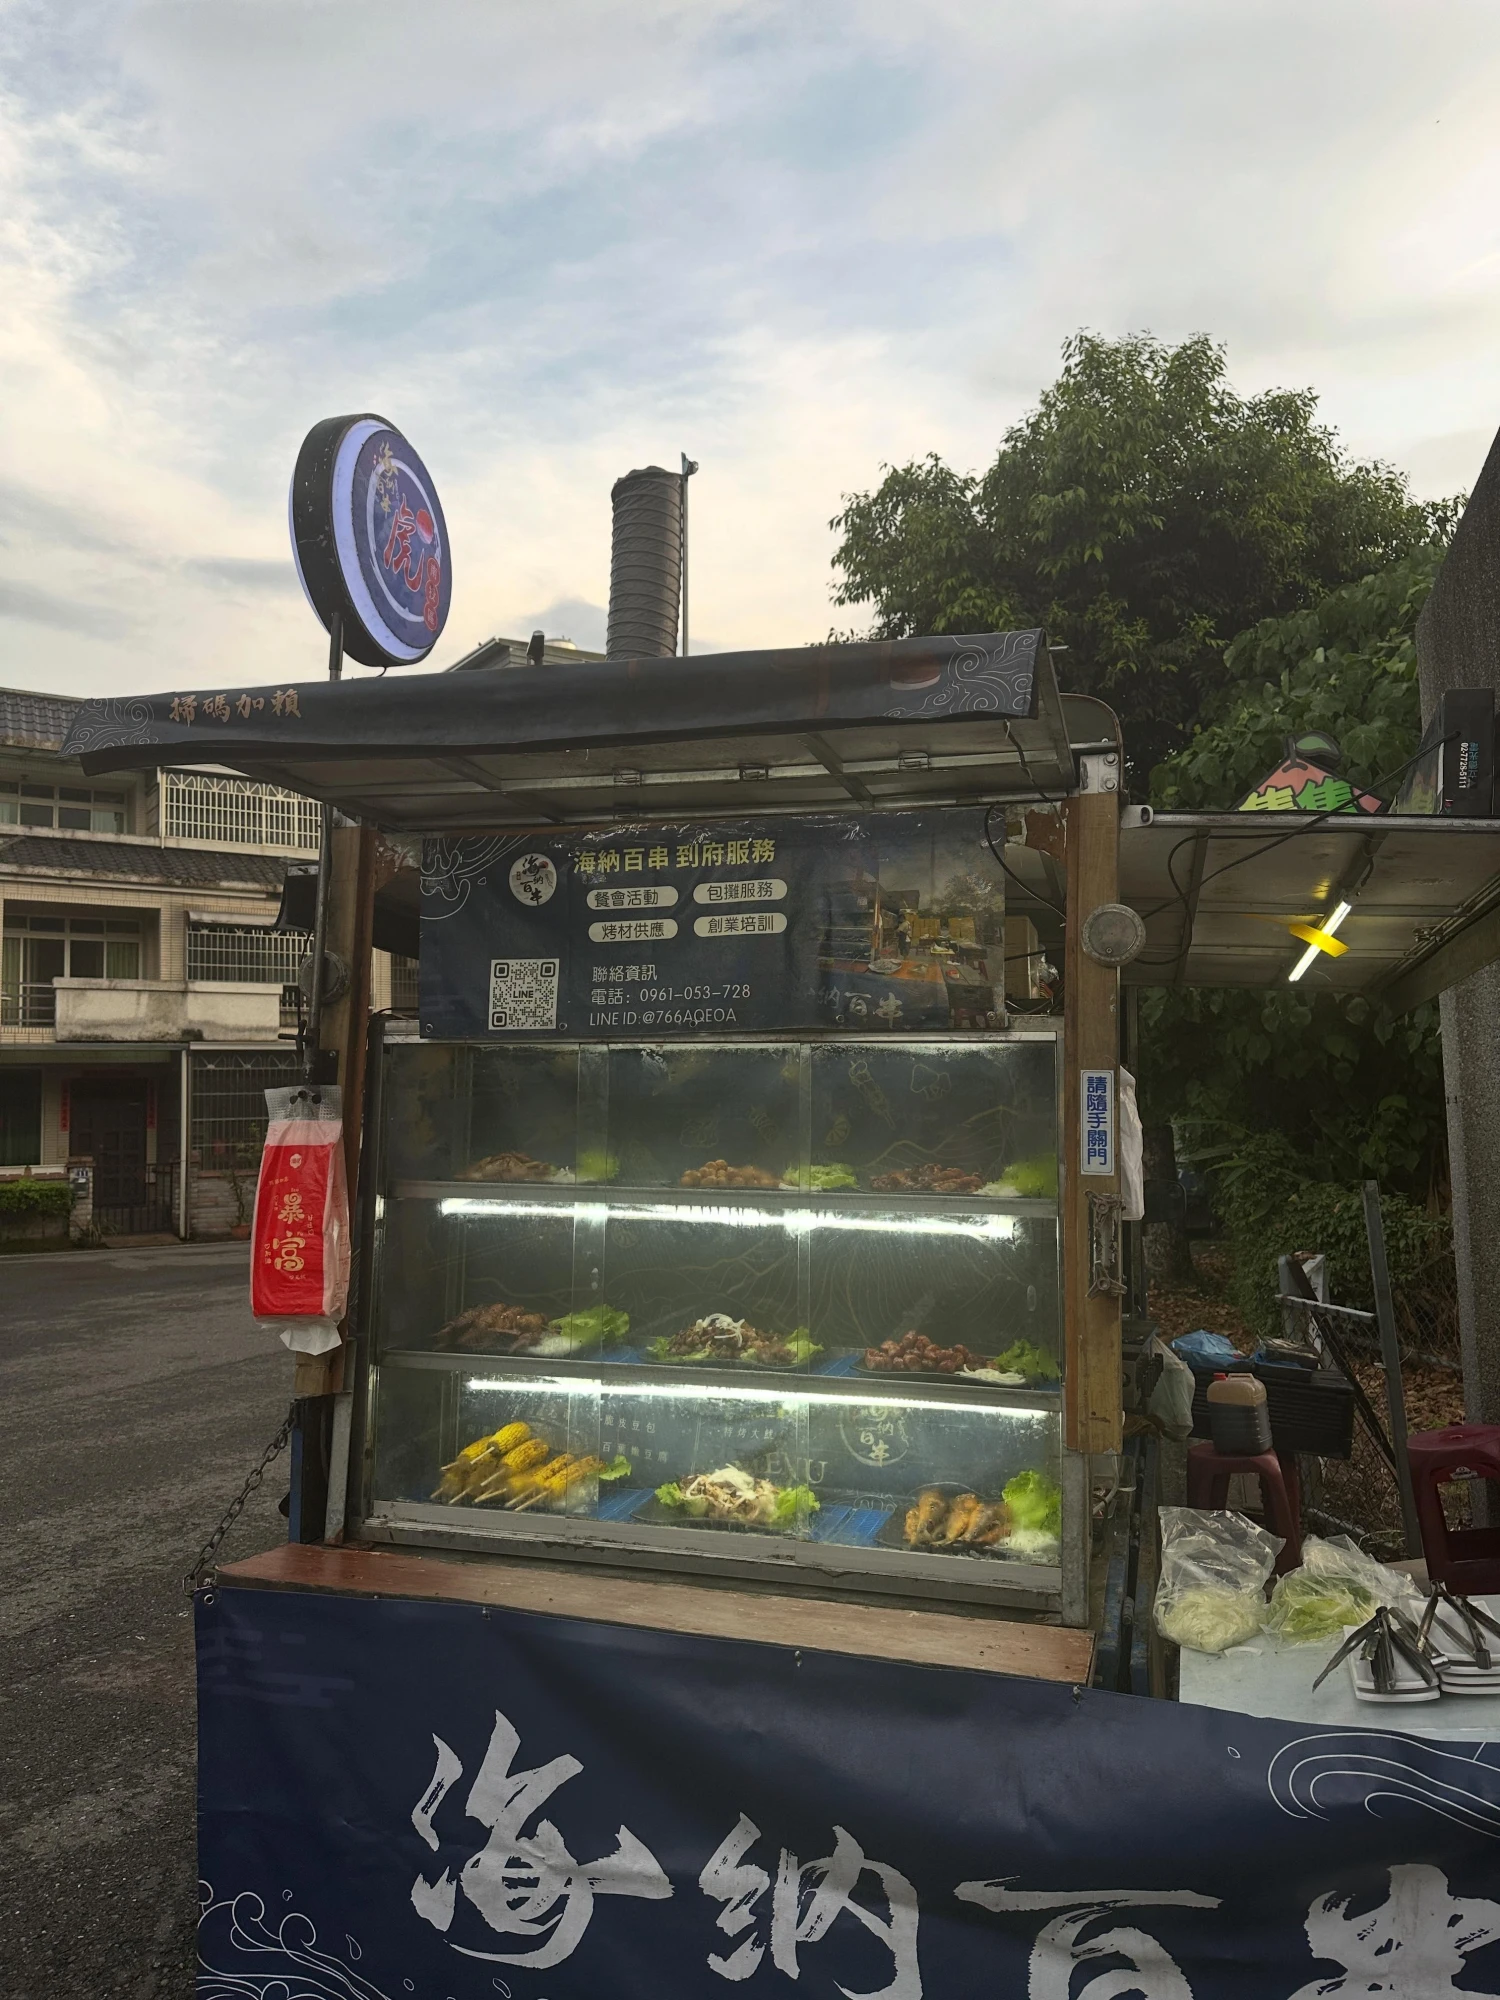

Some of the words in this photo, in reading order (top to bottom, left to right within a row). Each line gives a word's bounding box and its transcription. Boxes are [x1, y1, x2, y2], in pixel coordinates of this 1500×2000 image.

[169, 688, 302, 728] 掃碼加賴
[574, 845, 669, 874] 海納百串
[675, 838, 776, 869] 到府服務
[594, 889, 659, 908] 餐會活動
[707, 881, 774, 901] 包攤服務
[601, 921, 665, 940] 烤材供應
[708, 915, 775, 934] 創業培訓
[591, 964, 658, 983] 聯絡資訊
[512, 990, 534, 999] LINE
[589, 1011, 619, 1026] LINE
[1086, 1076, 1108, 1166] 請隨手關門
